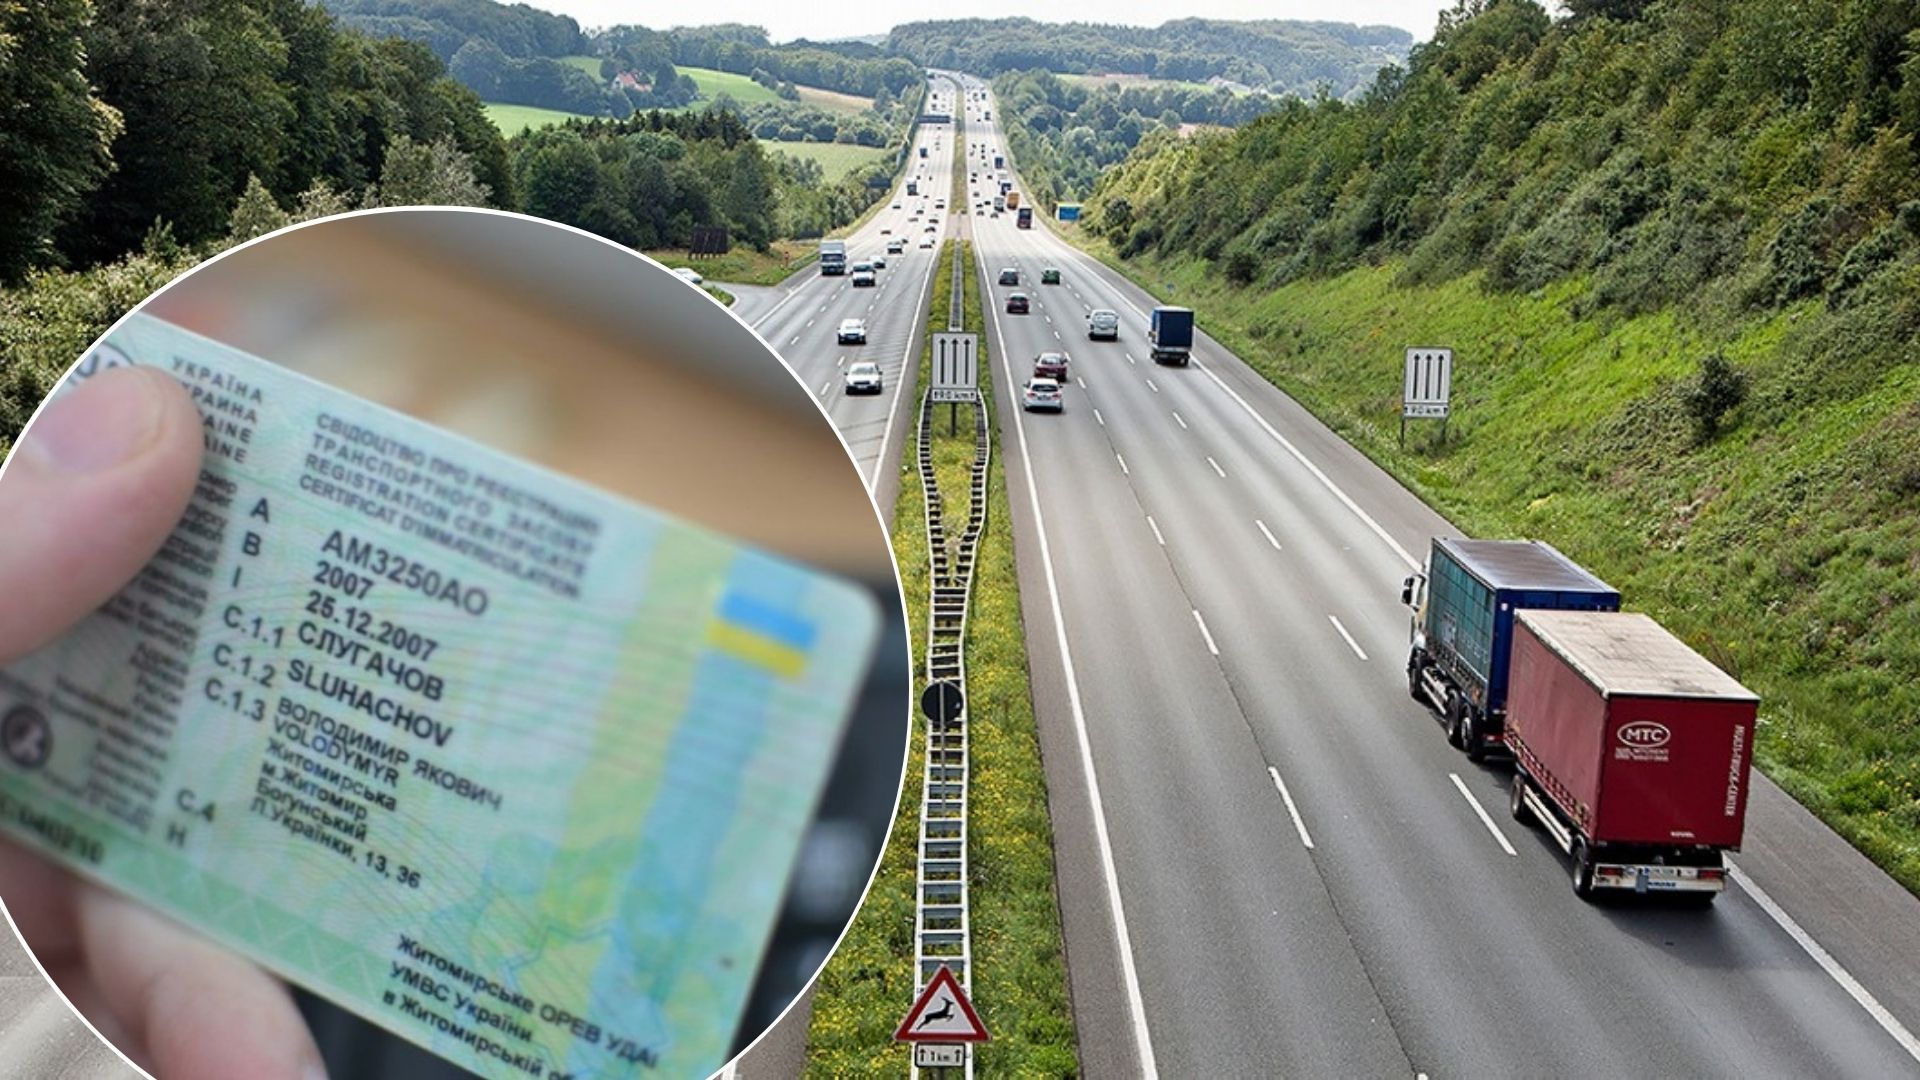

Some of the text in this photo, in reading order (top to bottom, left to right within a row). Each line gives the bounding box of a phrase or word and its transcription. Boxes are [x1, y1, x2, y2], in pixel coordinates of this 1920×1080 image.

[172, 356, 262, 403] УКРАЇНА
[312, 433, 492, 518] ТРАНСПОРТНОГО
[316, 413, 425, 467] СВІДОЦТВО
[429, 457, 469, 485] ПРО
[250, 497, 269, 523] A
[299, 474, 397, 525] CERTIFICAT
[305, 453, 585, 578] REGISTRATION CERTIFICATE
[242, 531, 262, 557] B
[313, 560, 375, 600] 2007
[223, 604, 284, 649] C.1.1
[231, 565, 242, 588] I
[304, 589, 439, 661] 25.12.2007
[213, 643, 275, 689] C.1.2
[297, 620, 445, 701] СЛУГАЧОВ
[204, 677, 266, 722] C.1.3
[287, 658, 453, 748] SLUHACHOV
[1626, 728, 1663, 742] MTC
[266, 738, 398, 812] Житомирська
[273, 715, 400, 788] VOLODYMYR
[277, 696, 503, 812] ВОЛОДИМИР ЯКОВИЧ
[176, 788, 216, 823] C.4
[256, 777, 367, 843] Богунський
[365, 850, 390, 878] 13,
[397, 864, 421, 889] 36
[390, 961, 533, 1043] УМВС України
[397, 934, 534, 1014] Житомирське
[540, 1004, 602, 1044] ОРЕВ
[399, 995, 544, 1077] Житомирській
